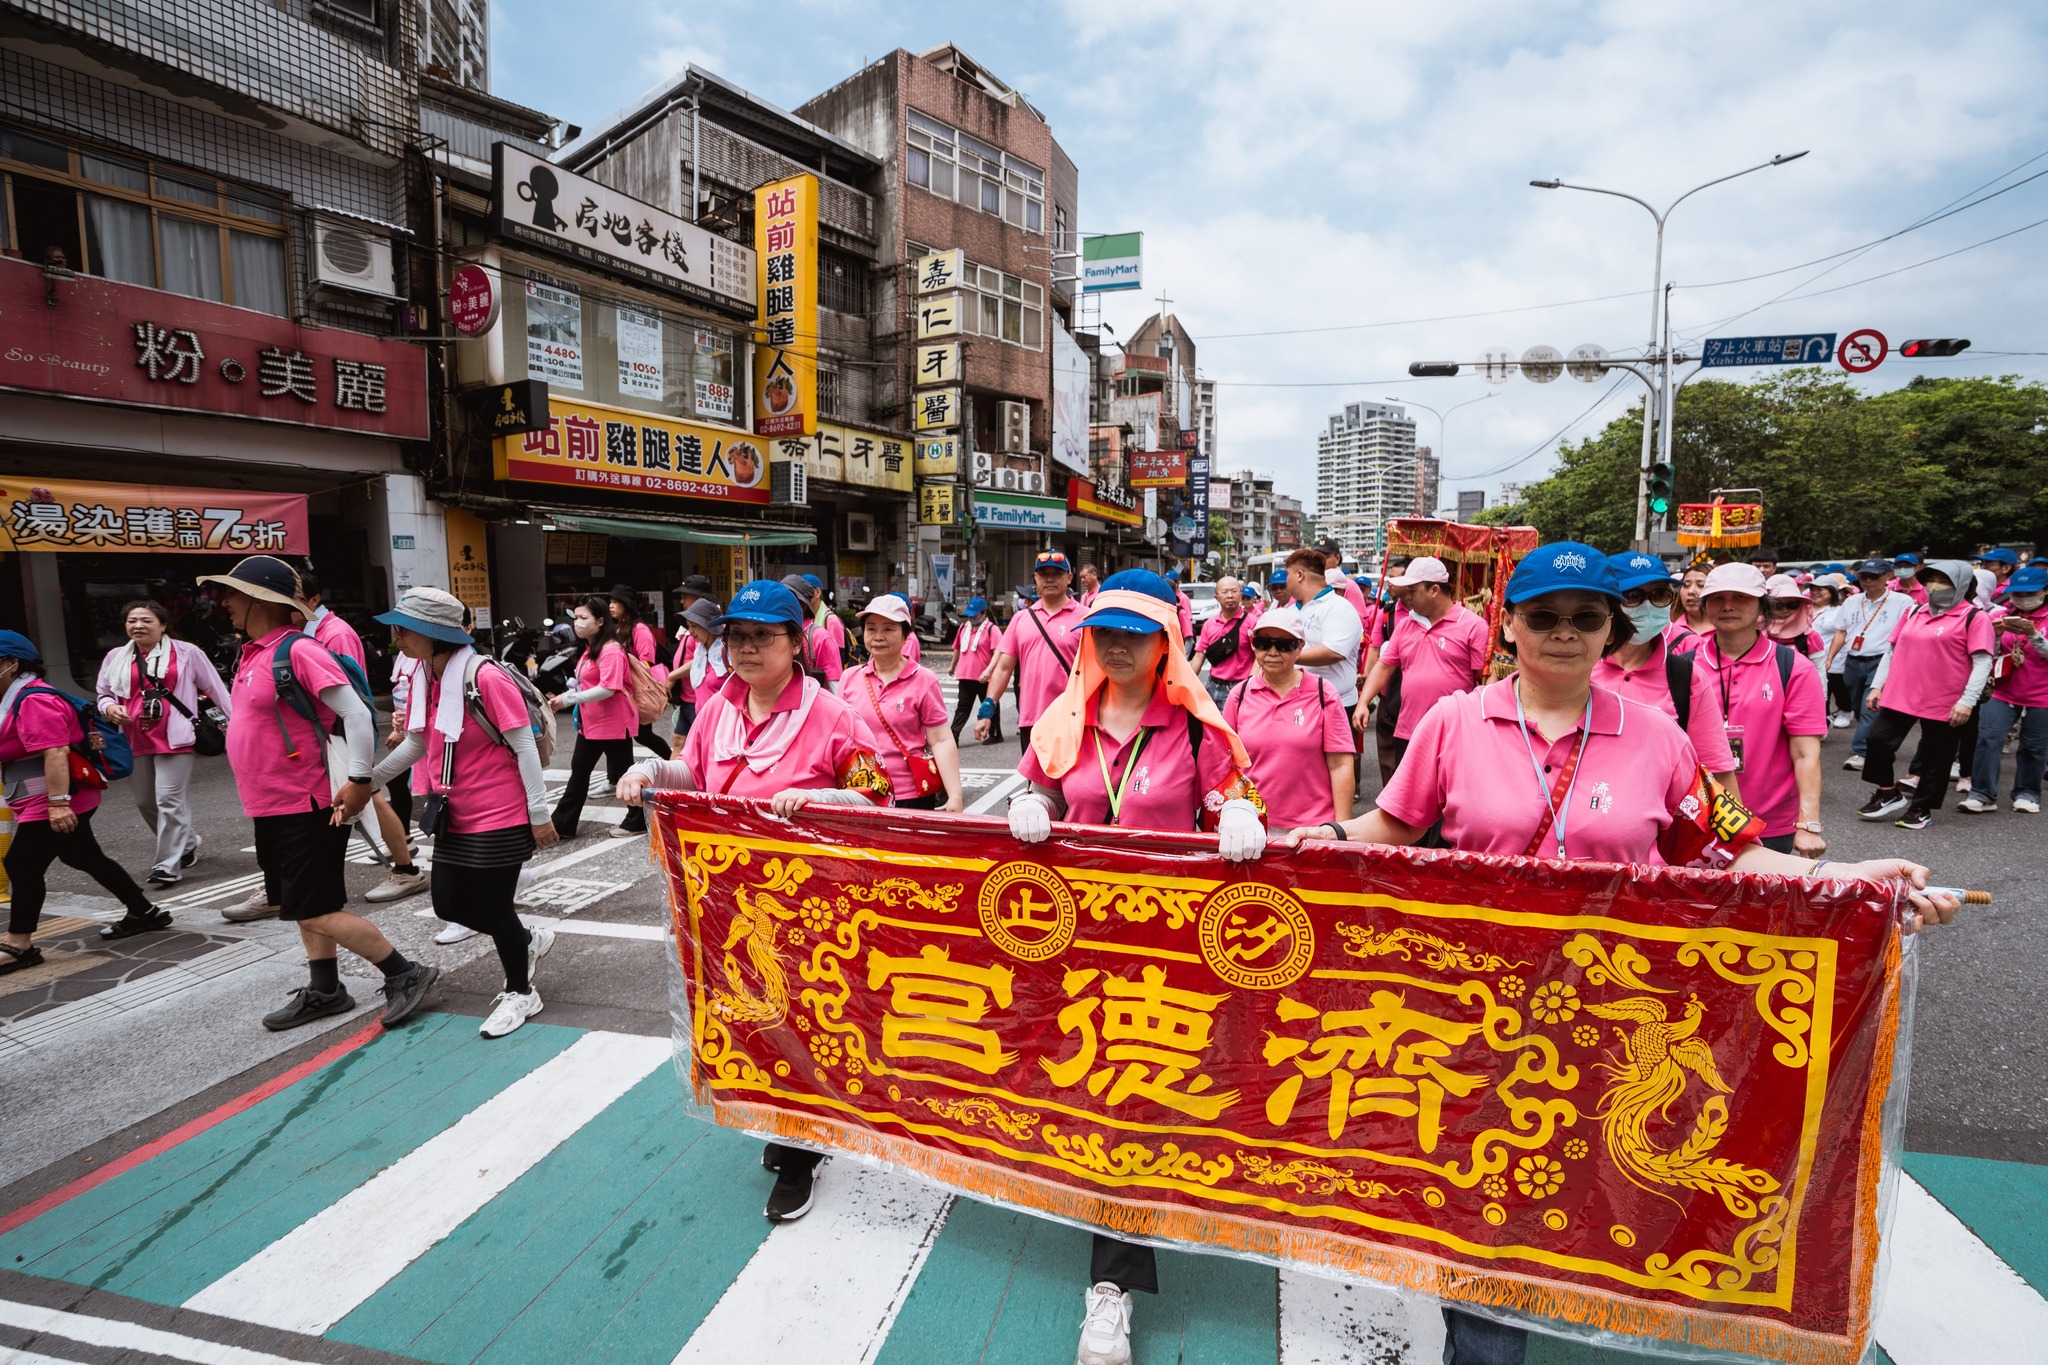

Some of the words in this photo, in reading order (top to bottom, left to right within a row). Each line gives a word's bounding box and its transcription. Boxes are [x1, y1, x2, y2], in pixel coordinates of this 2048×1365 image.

[576, 197, 689, 273] 房地客棧
[1085, 264, 1138, 277] FamilyMart
[767, 189, 796, 379] 站前雞腿達人
[920, 258, 953, 425] 嘉仁牙醫
[1707, 338, 1782, 356] 汐止火車站
[545, 344, 576, 360] 4480
[1708, 357, 1733, 366] Xizhi
[1736, 355, 1774, 365] Station
[5, 347, 33, 361] So
[39, 353, 110, 376] Beauty
[633, 362, 656, 375] 1050
[709, 383, 729, 399] 888
[760, 421, 800, 433] 02-8692-4231
[575, 468, 641, 486] 訂購外送專線
[646, 477, 729, 495] 02-8692-4231
[924, 489, 950, 501] 嘉仁
[923, 503, 951, 521] 牙醫
[991, 507, 1045, 524] FamilyMart
